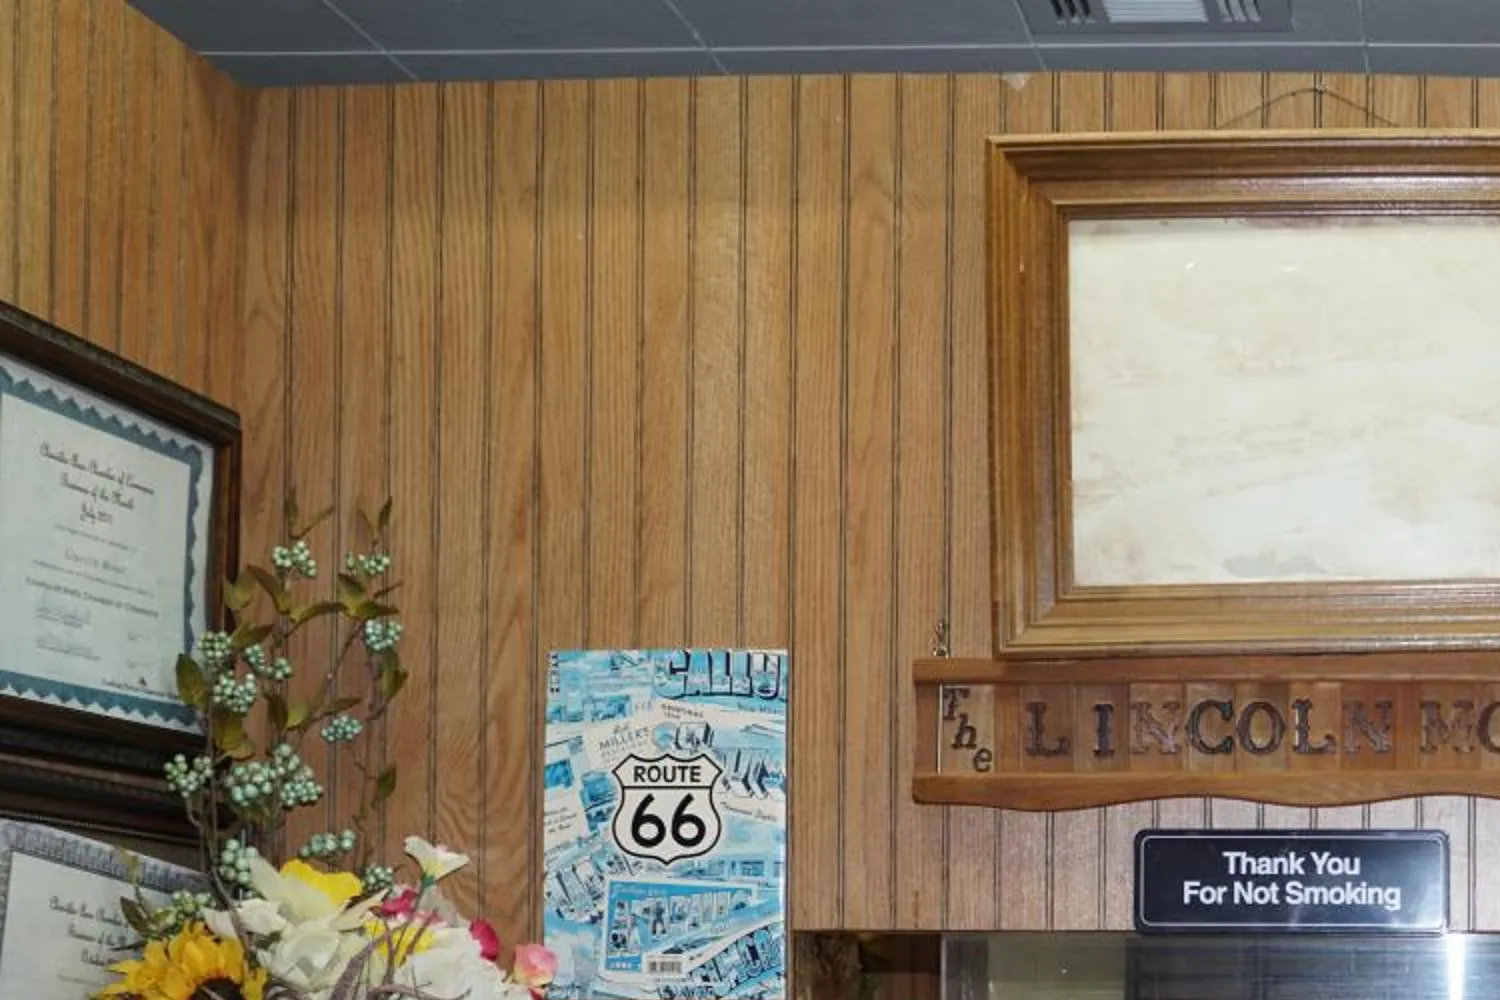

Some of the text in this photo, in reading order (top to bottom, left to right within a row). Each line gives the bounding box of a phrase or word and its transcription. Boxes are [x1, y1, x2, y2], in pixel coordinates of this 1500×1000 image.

[942, 687, 993, 773] The
[1025, 699, 1394, 757] LINCOLN
[633, 765, 702, 783] ROUTE
[631, 793, 707, 849] 66
[1222, 851, 1361, 876] Thank You
[1183, 881, 1401, 911] For Not Smoking
